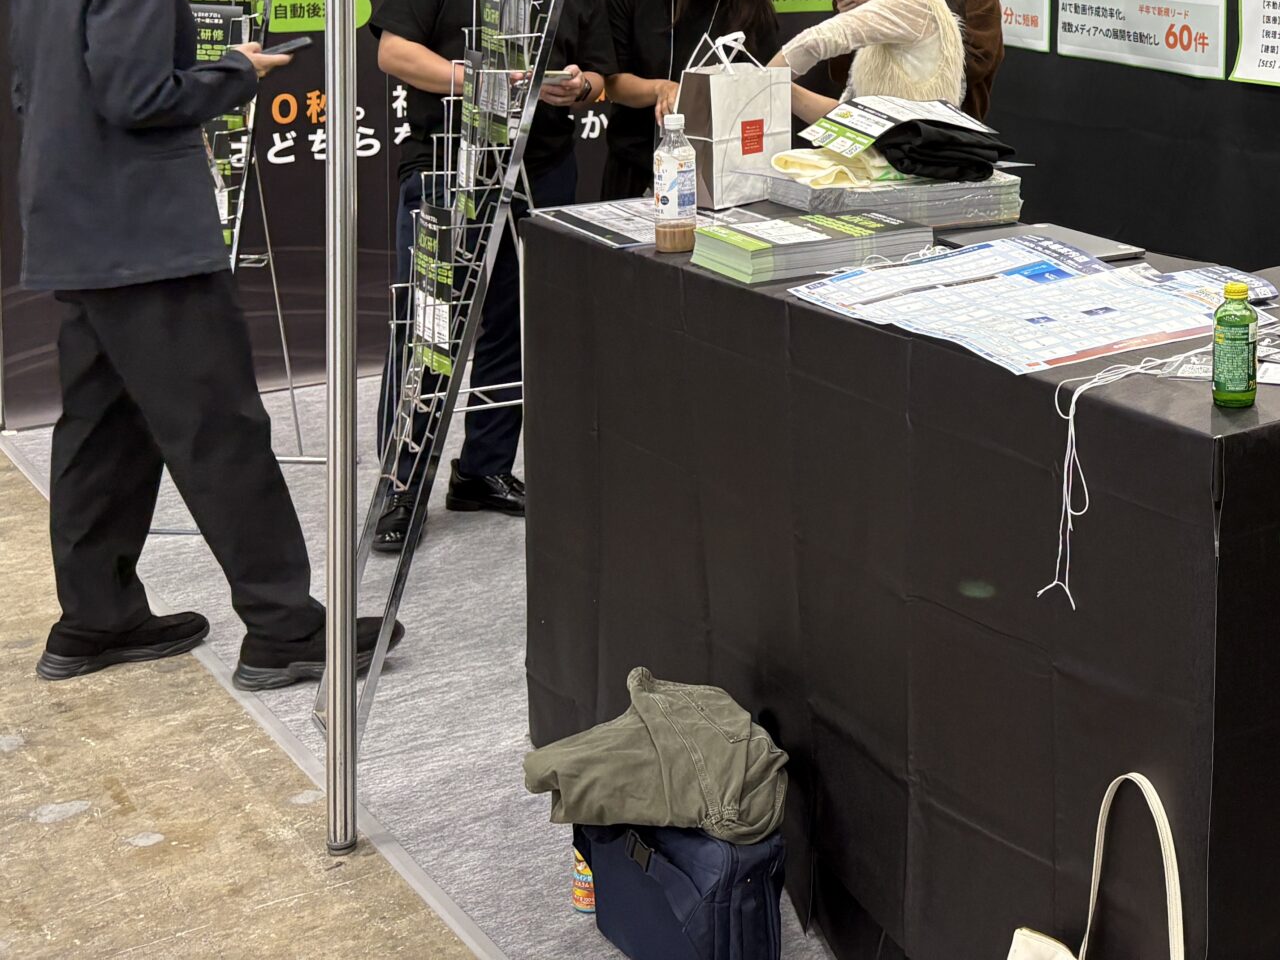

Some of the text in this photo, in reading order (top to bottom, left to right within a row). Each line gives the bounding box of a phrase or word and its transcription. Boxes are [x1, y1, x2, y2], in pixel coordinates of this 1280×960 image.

[273, 3, 326, 21] 自動後
[1001, 7, 1039, 29] 分に短縮
[1164, 23, 1209, 53] 60件
